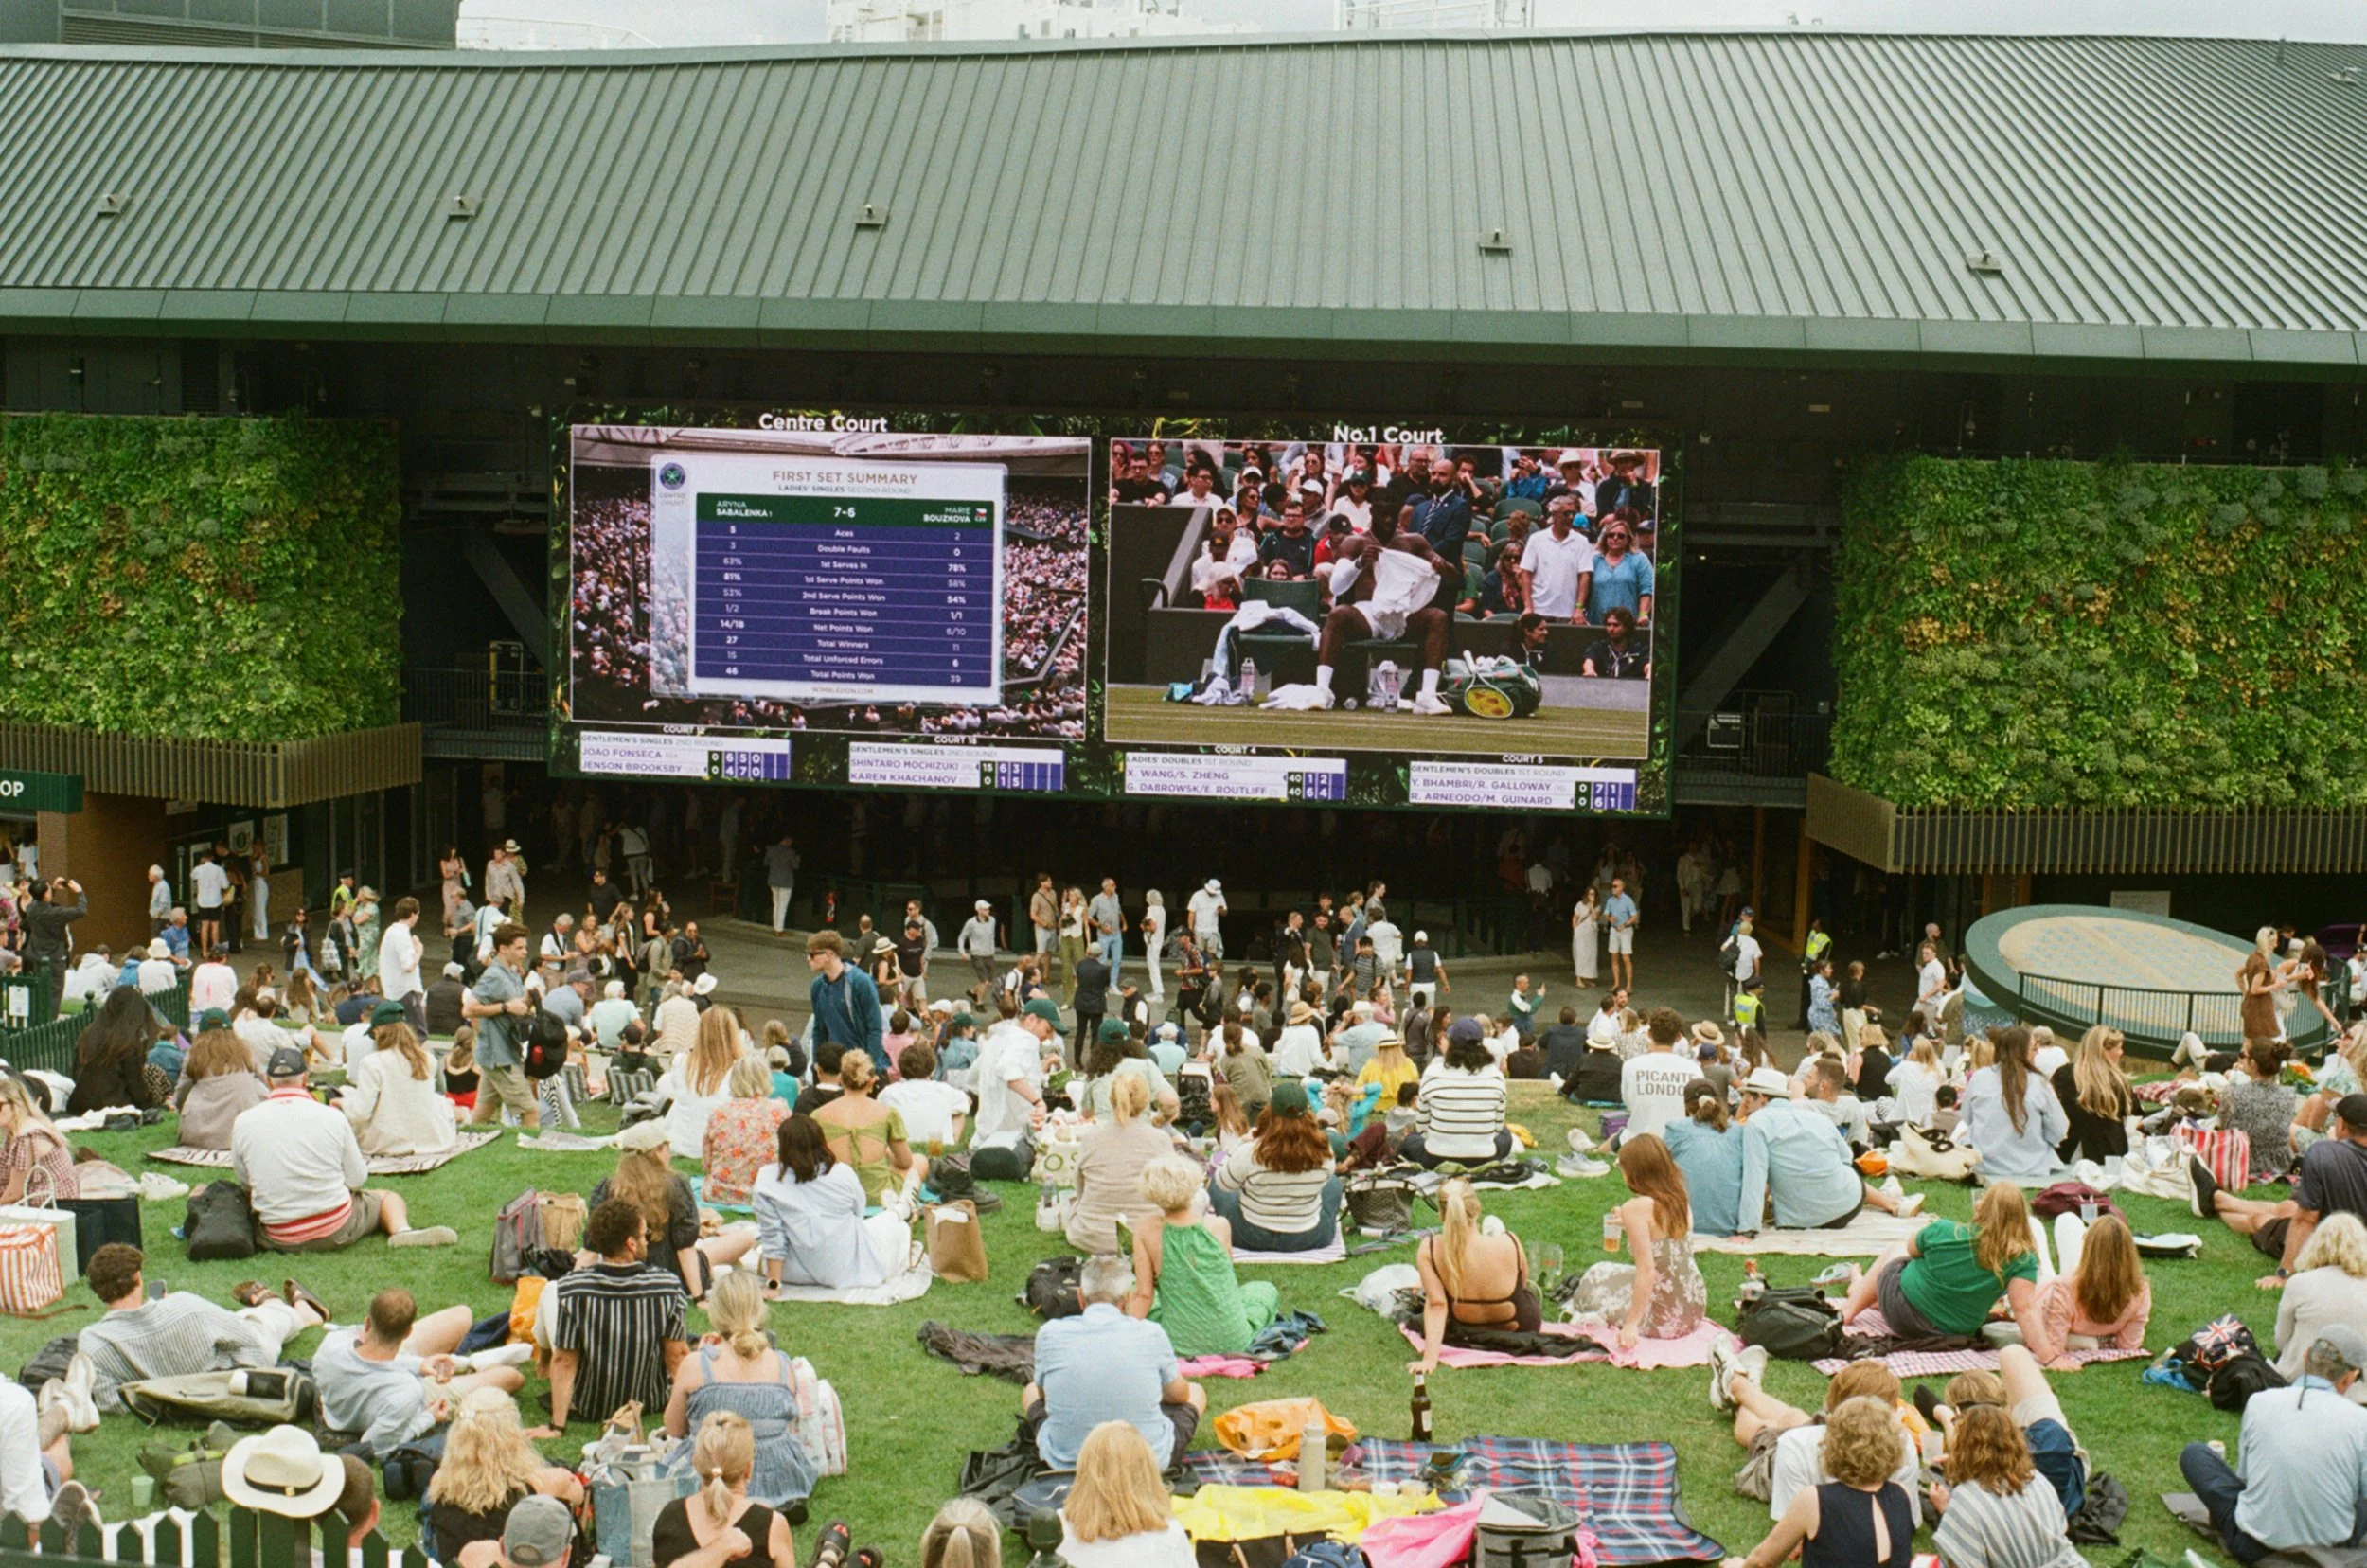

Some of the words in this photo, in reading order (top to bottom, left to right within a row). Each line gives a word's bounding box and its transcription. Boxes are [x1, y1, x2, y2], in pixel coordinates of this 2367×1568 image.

[759, 413, 825, 430] Centre
[831, 415, 887, 432] Court
[1334, 425, 1377, 442] No.1
[1383, 426, 1443, 443] Court
[773, 471, 811, 481] FIRST
[818, 472, 842, 482] SET
[847, 473, 917, 484] SUMMARY
[716, 508, 767, 517] SABALENKA
[834, 507, 856, 518] 7-6
[923, 514, 970, 523] BOUZKOVA
[954, 532, 961, 541] 2
[847, 545, 870, 554] Faults
[725, 604, 739, 613] 1/2
[838, 640, 869, 649] Winners
[663, 725, 694, 734] COURT
[582, 735, 637, 743] GENTLEMEN'S
[613, 749, 662, 758] FONSECA
[1215, 745, 1248, 754] COURT
[712, 753, 720, 761] 0
[725, 754, 734, 762] 6
[739, 754, 747, 763] 5
[752, 754, 760, 763] 0
[1503, 755, 1535, 763] COURT
[583, 761, 622, 770] JENSON
[626, 763, 682, 773] BROOKSBY
[851, 758, 900, 768] SHINTARO
[903, 761, 958, 770] MOCHIZUKI
[982, 763, 992, 772] 15
[999, 764, 1007, 773] 6
[711, 766, 720, 775] 0
[725, 767, 734, 775] 4
[739, 767, 747, 775] 7
[752, 768, 760, 776] 0
[1012, 764, 1020, 774] 3
[890, 775, 957, 784] KHACHANOV
[1141, 770, 1188, 779] WANG/S.
[1193, 772, 1230, 780] ZHENG
[1289, 775, 1302, 783] 40
[1308, 775, 1313, 783] 1
[1320, 775, 1327, 784] 2
[984, 776, 992, 785] 0
[1001, 776, 1006, 786] 1
[1012, 777, 1020, 787] 5
[1216, 786, 1267, 794] ROUTLIFF
[1423, 779, 1487, 789] BHAMBRI/R.
[1492, 780, 1551, 792] GALLOWAY
[1579, 784, 1588, 793] 0
[1595, 784, 1604, 793] 7
[1610, 784, 1616, 793] 1
[1289, 788, 1302, 796] 40
[1307, 788, 1314, 797] 6
[1319, 788, 1327, 797] 4
[1425, 793, 1497, 803] ARNEODO/M.
[1502, 794, 1552, 805] GUINARD
[1578, 797, 1587, 806] 0
[1594, 797, 1603, 807] 6
[1610, 798, 1615, 808] 1
